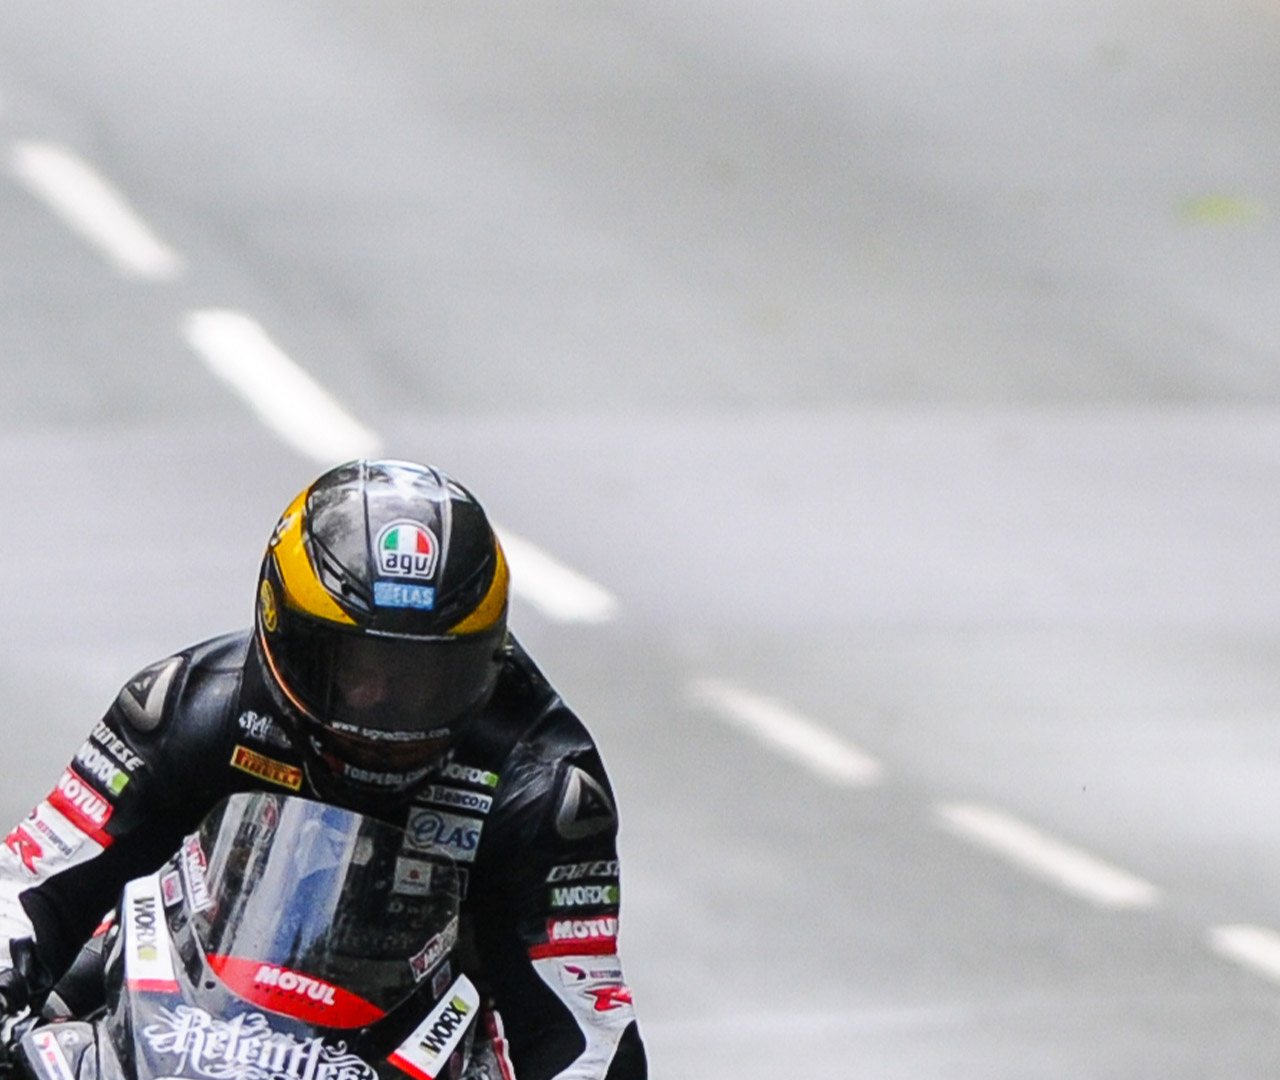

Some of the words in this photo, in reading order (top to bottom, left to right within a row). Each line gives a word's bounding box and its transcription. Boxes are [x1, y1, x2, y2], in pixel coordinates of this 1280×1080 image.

[133, 896, 158, 960] WORX
[254, 965, 336, 1006] MOTUL
[420, 997, 469, 1055] WORX
